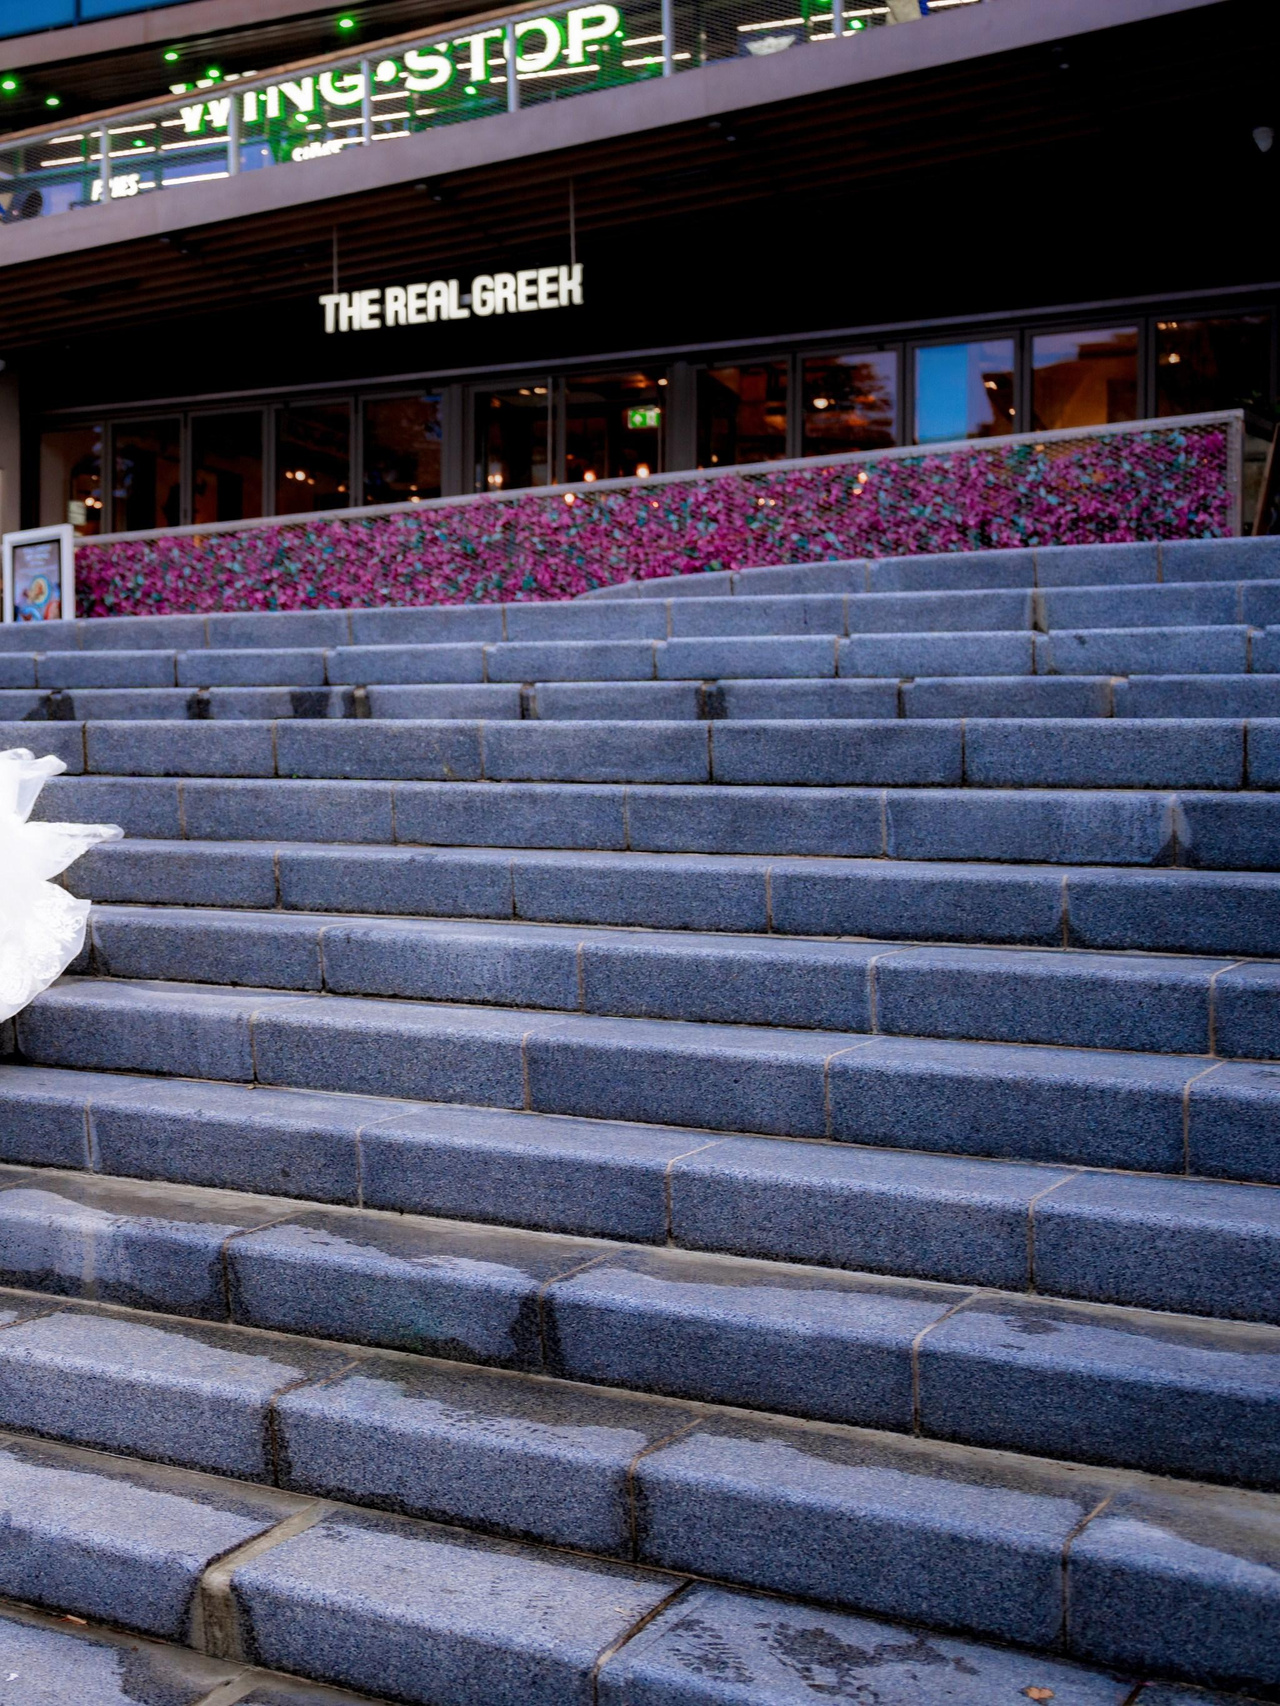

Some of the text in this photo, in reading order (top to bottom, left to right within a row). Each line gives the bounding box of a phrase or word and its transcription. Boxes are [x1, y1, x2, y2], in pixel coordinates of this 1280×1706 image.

[319, 262, 584, 334] THE REAL GREEK
